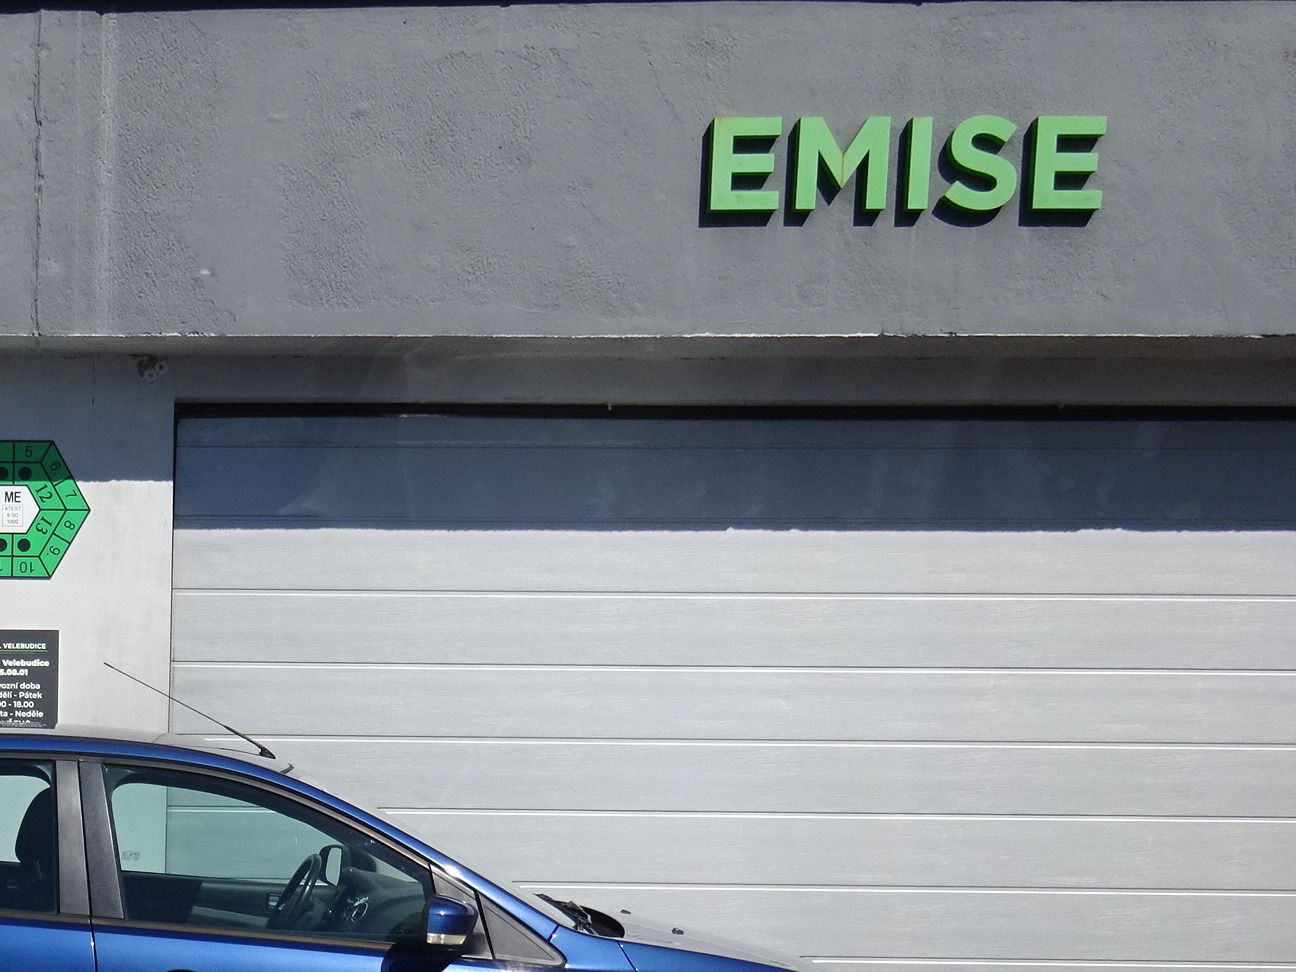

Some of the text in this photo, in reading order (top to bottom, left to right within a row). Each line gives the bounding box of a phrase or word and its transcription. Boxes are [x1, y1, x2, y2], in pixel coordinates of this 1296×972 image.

[706, 114, 1108, 214] EMISE
[25, 446, 33, 458] 5
[4, 491, 21, 503] ME
[35, 484, 53, 504] 12
[65, 489, 77, 499] 7
[35, 516, 53, 535] 13
[64, 520, 76, 530] 8
[19, 561, 34, 573] 10
[2, 659, 49, 667] Velebudice
[19, 691, 42, 699] Pátek
[15, 710, 43, 718] Neděle
